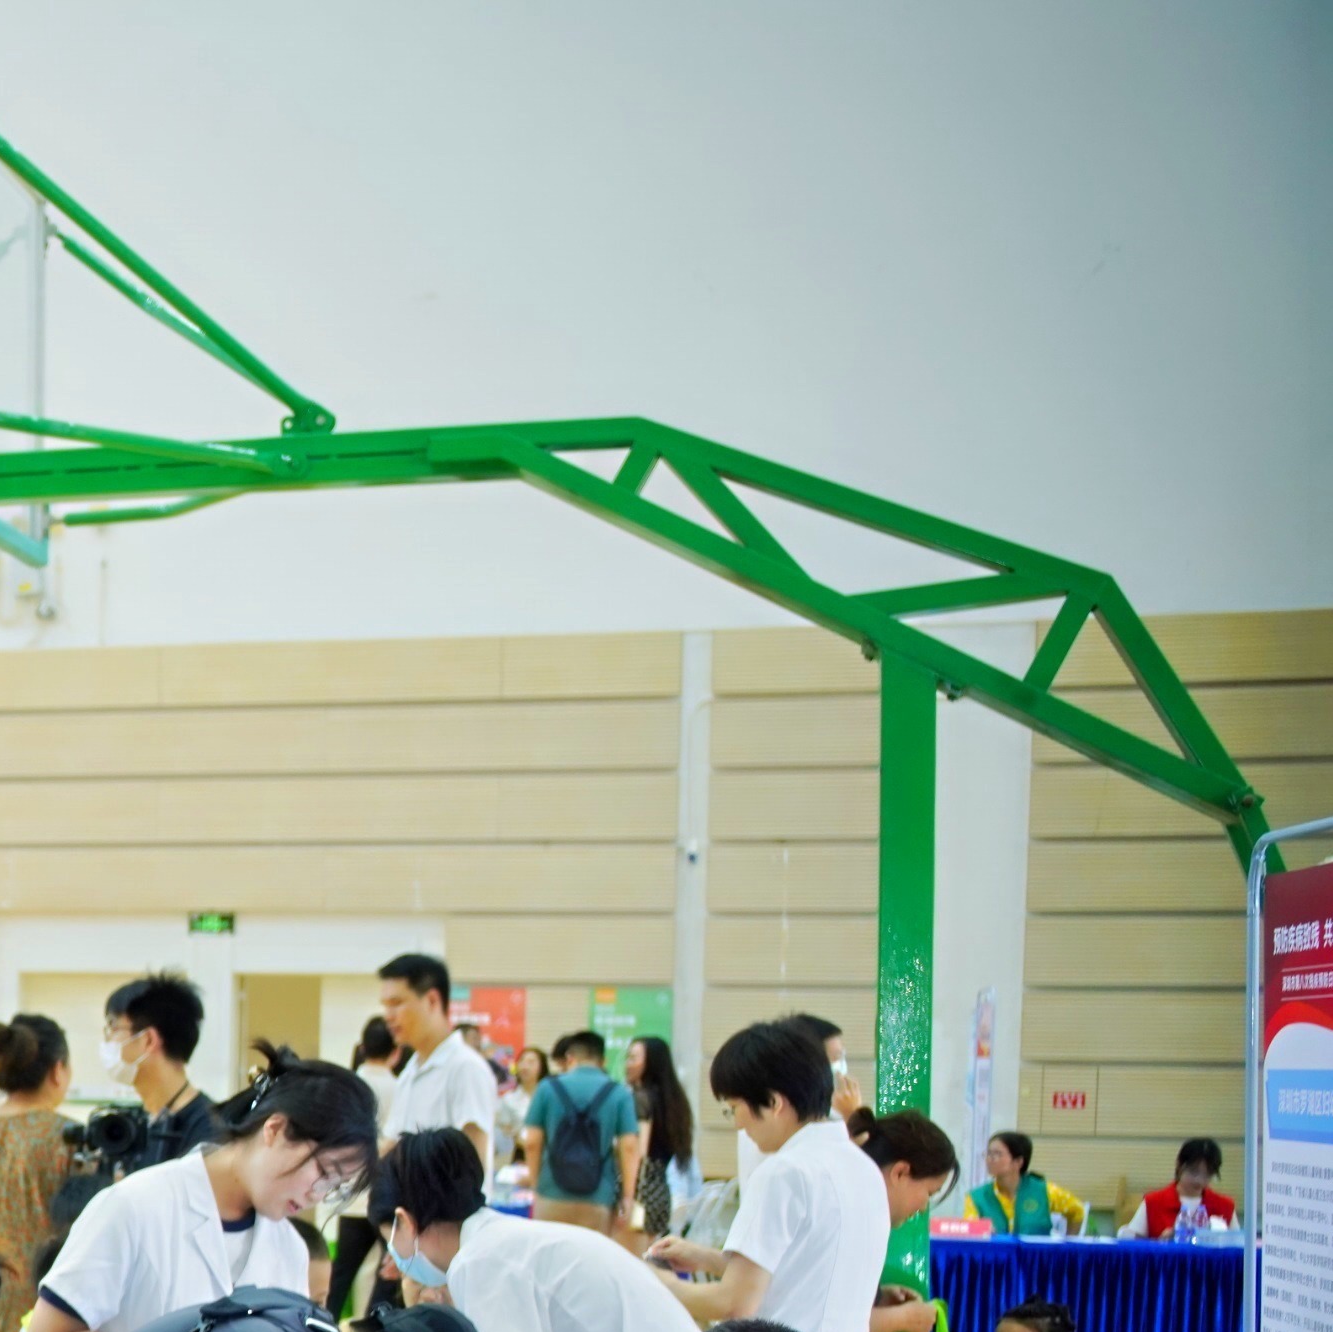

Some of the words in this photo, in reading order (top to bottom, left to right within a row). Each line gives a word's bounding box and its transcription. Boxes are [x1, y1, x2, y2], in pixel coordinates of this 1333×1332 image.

[1273, 920, 1320, 955] 预防疾病致残
